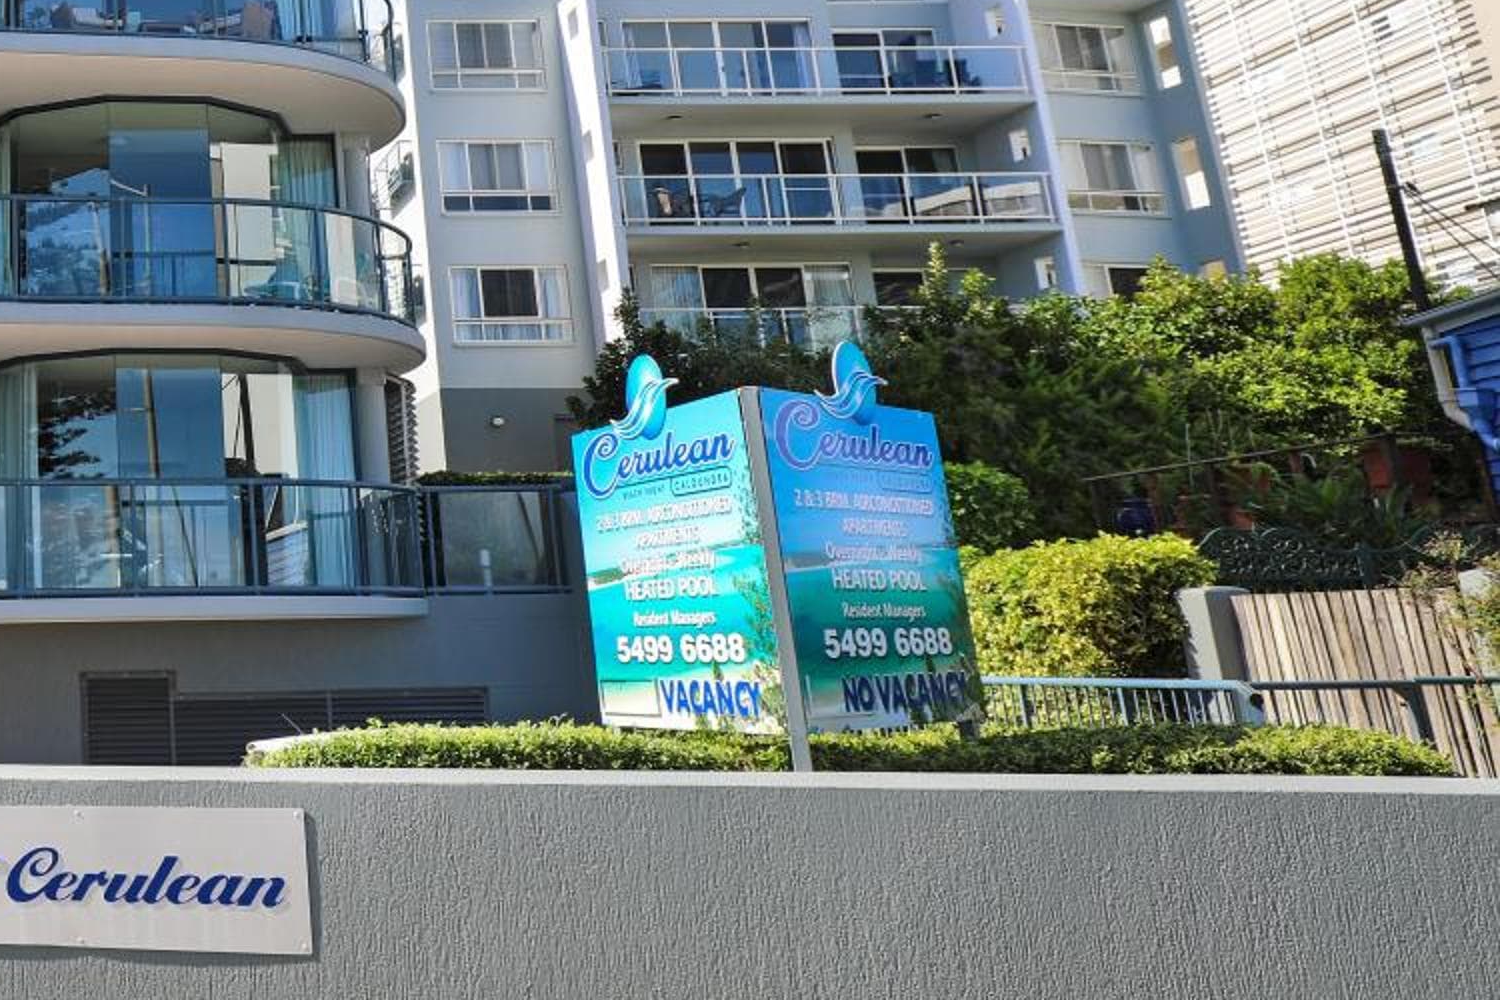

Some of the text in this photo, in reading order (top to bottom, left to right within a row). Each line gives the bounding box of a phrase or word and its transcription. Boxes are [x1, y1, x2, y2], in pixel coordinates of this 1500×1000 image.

[775, 400, 932, 470] Cerulean
[583, 432, 734, 498] Cerulean
[627, 576, 717, 600] HEATED POOL
[832, 567, 927, 592] HEATED POOL
[843, 602, 880, 618] Resident
[617, 632, 745, 663] 5499 6688
[824, 627, 953, 659] 5499 6688
[660, 679, 762, 718] VACANCY
[842, 671, 967, 716] NO VACANCY
[6, 847, 286, 907] Cerulean
